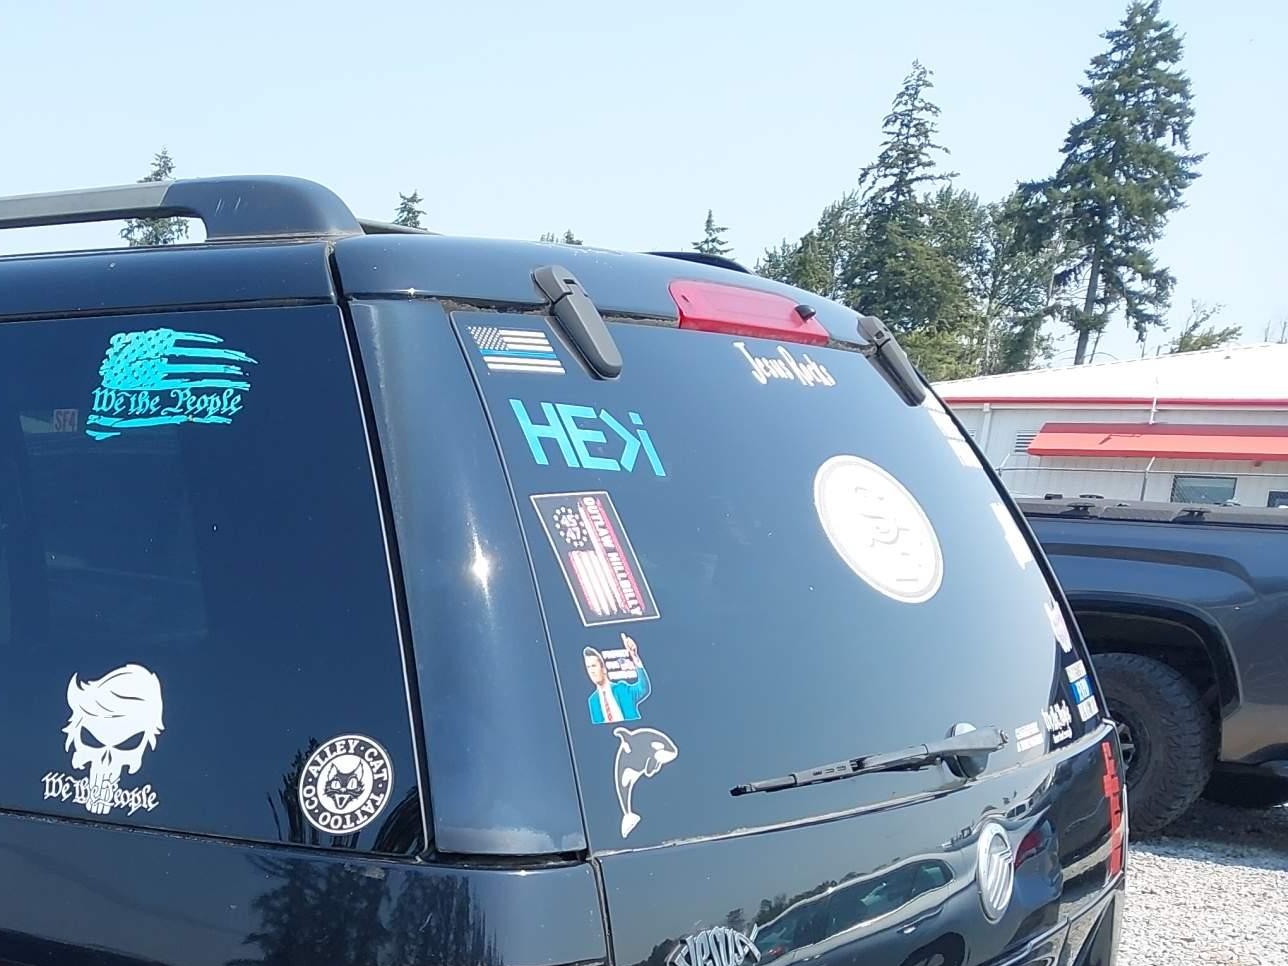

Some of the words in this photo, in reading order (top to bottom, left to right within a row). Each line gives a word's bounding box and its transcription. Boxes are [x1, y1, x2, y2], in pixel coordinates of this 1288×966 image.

[92, 387, 127, 416] We
[160, 387, 244, 419] People
[582, 496, 616, 549] OUTLAW
[307, 739, 361, 778] ALLEY
[364, 747, 388, 781] CAT
[41, 772, 73, 802] We
[94, 779, 160, 816] People
[303, 785, 319, 810] CO
[318, 792, 385, 834] TATTOO
